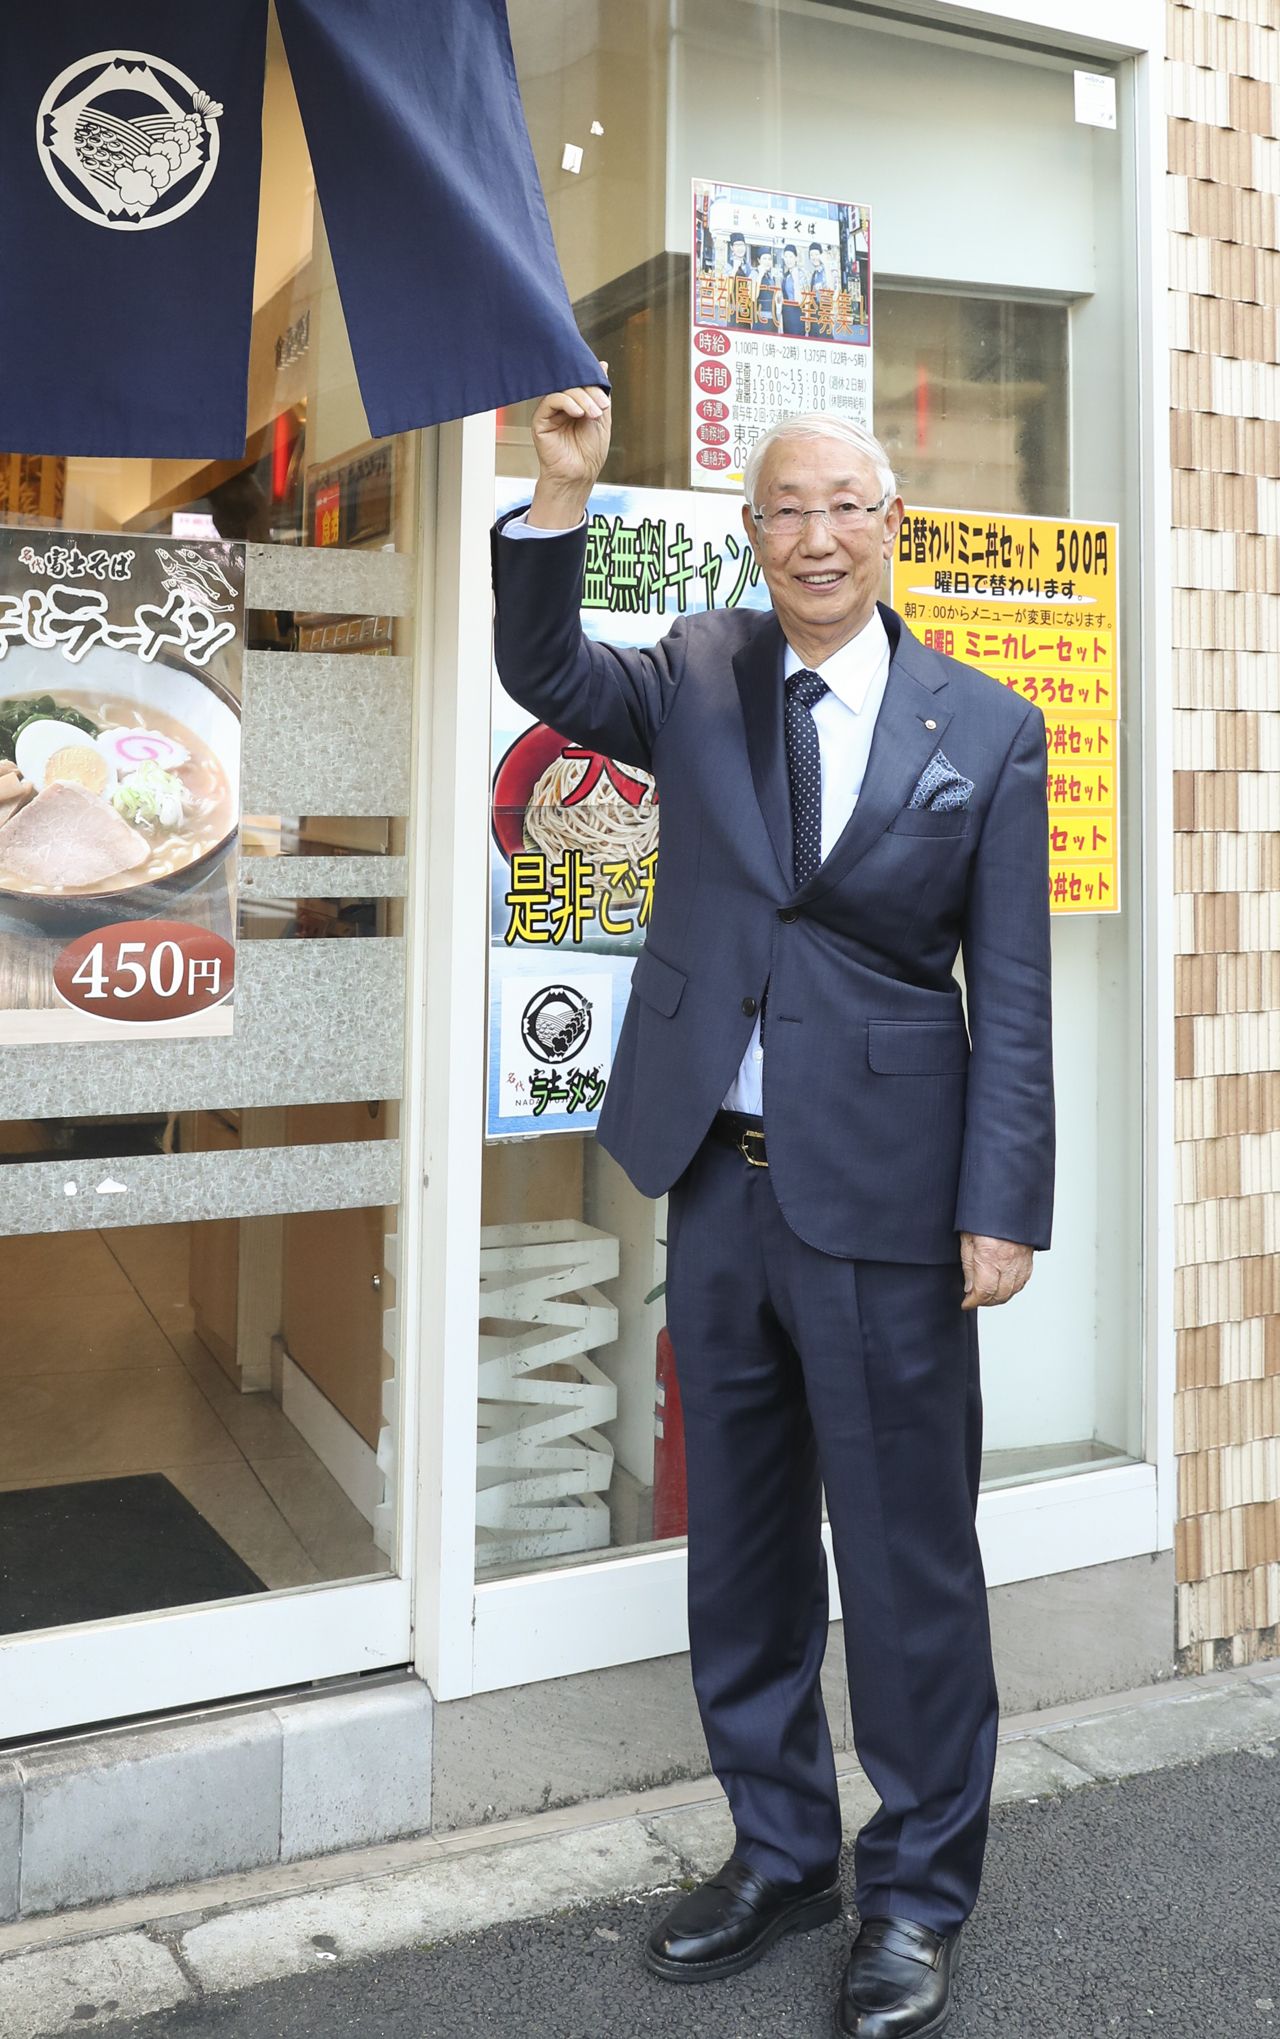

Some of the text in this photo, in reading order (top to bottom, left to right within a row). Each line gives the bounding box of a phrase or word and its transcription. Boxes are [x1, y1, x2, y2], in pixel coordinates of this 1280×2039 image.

[699, 332, 725, 353] 時給
[735, 340, 759, 357] 1,100円
[699, 366, 727, 388] 時間
[702, 401, 724, 418] 待遇
[899, 516, 1108, 576] 日替わりミニ丼セット 500円
[581, 513, 763, 615] 盛無料キャン
[934, 570, 1083, 602] 曜日で替わります。
[904, 602, 1113, 630] 朝7:00からメニューが変更になります。
[965, 631, 1108, 663] ミニカレーセット
[1050, 825, 1107, 851] セット
[1048, 871, 1110, 903] 丼セット
[71, 940, 222, 999] 450円
[530, 1077, 607, 1117] ラーメン
